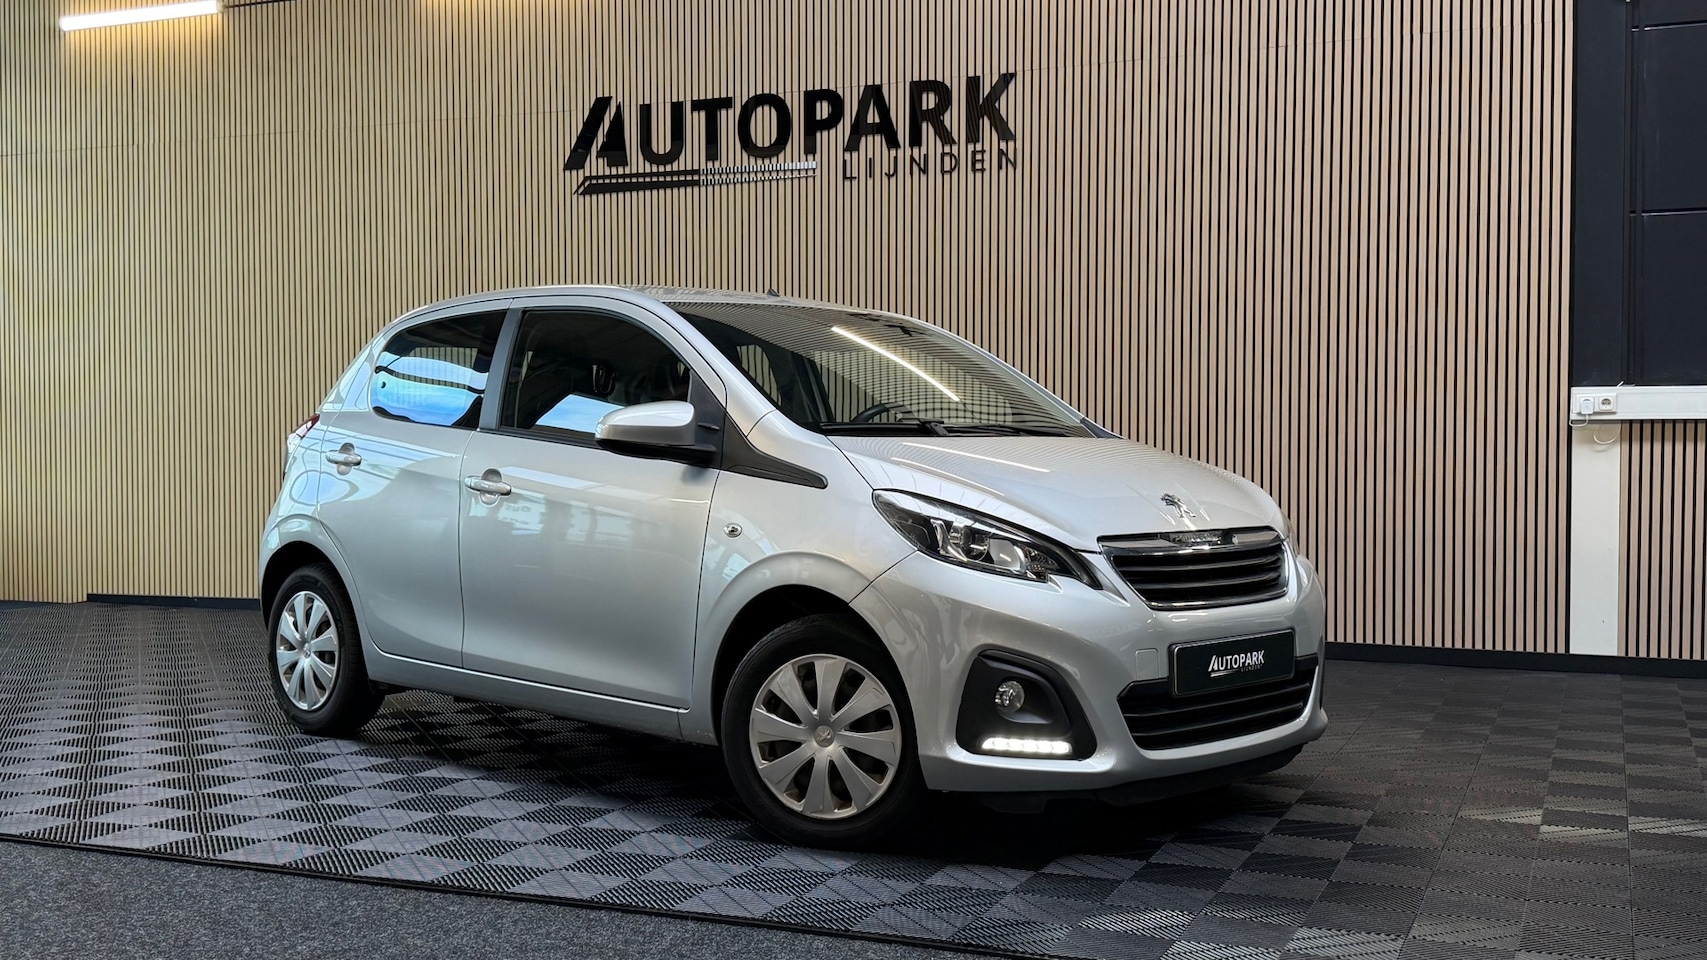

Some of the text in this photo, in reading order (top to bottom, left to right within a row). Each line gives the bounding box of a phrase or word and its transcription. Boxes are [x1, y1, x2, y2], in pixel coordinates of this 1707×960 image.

[563, 72, 1016, 171] AUTOPARK
[843, 147, 1018, 181] LIJNDEN
[1208, 650, 1264, 671] AUTOPARK
